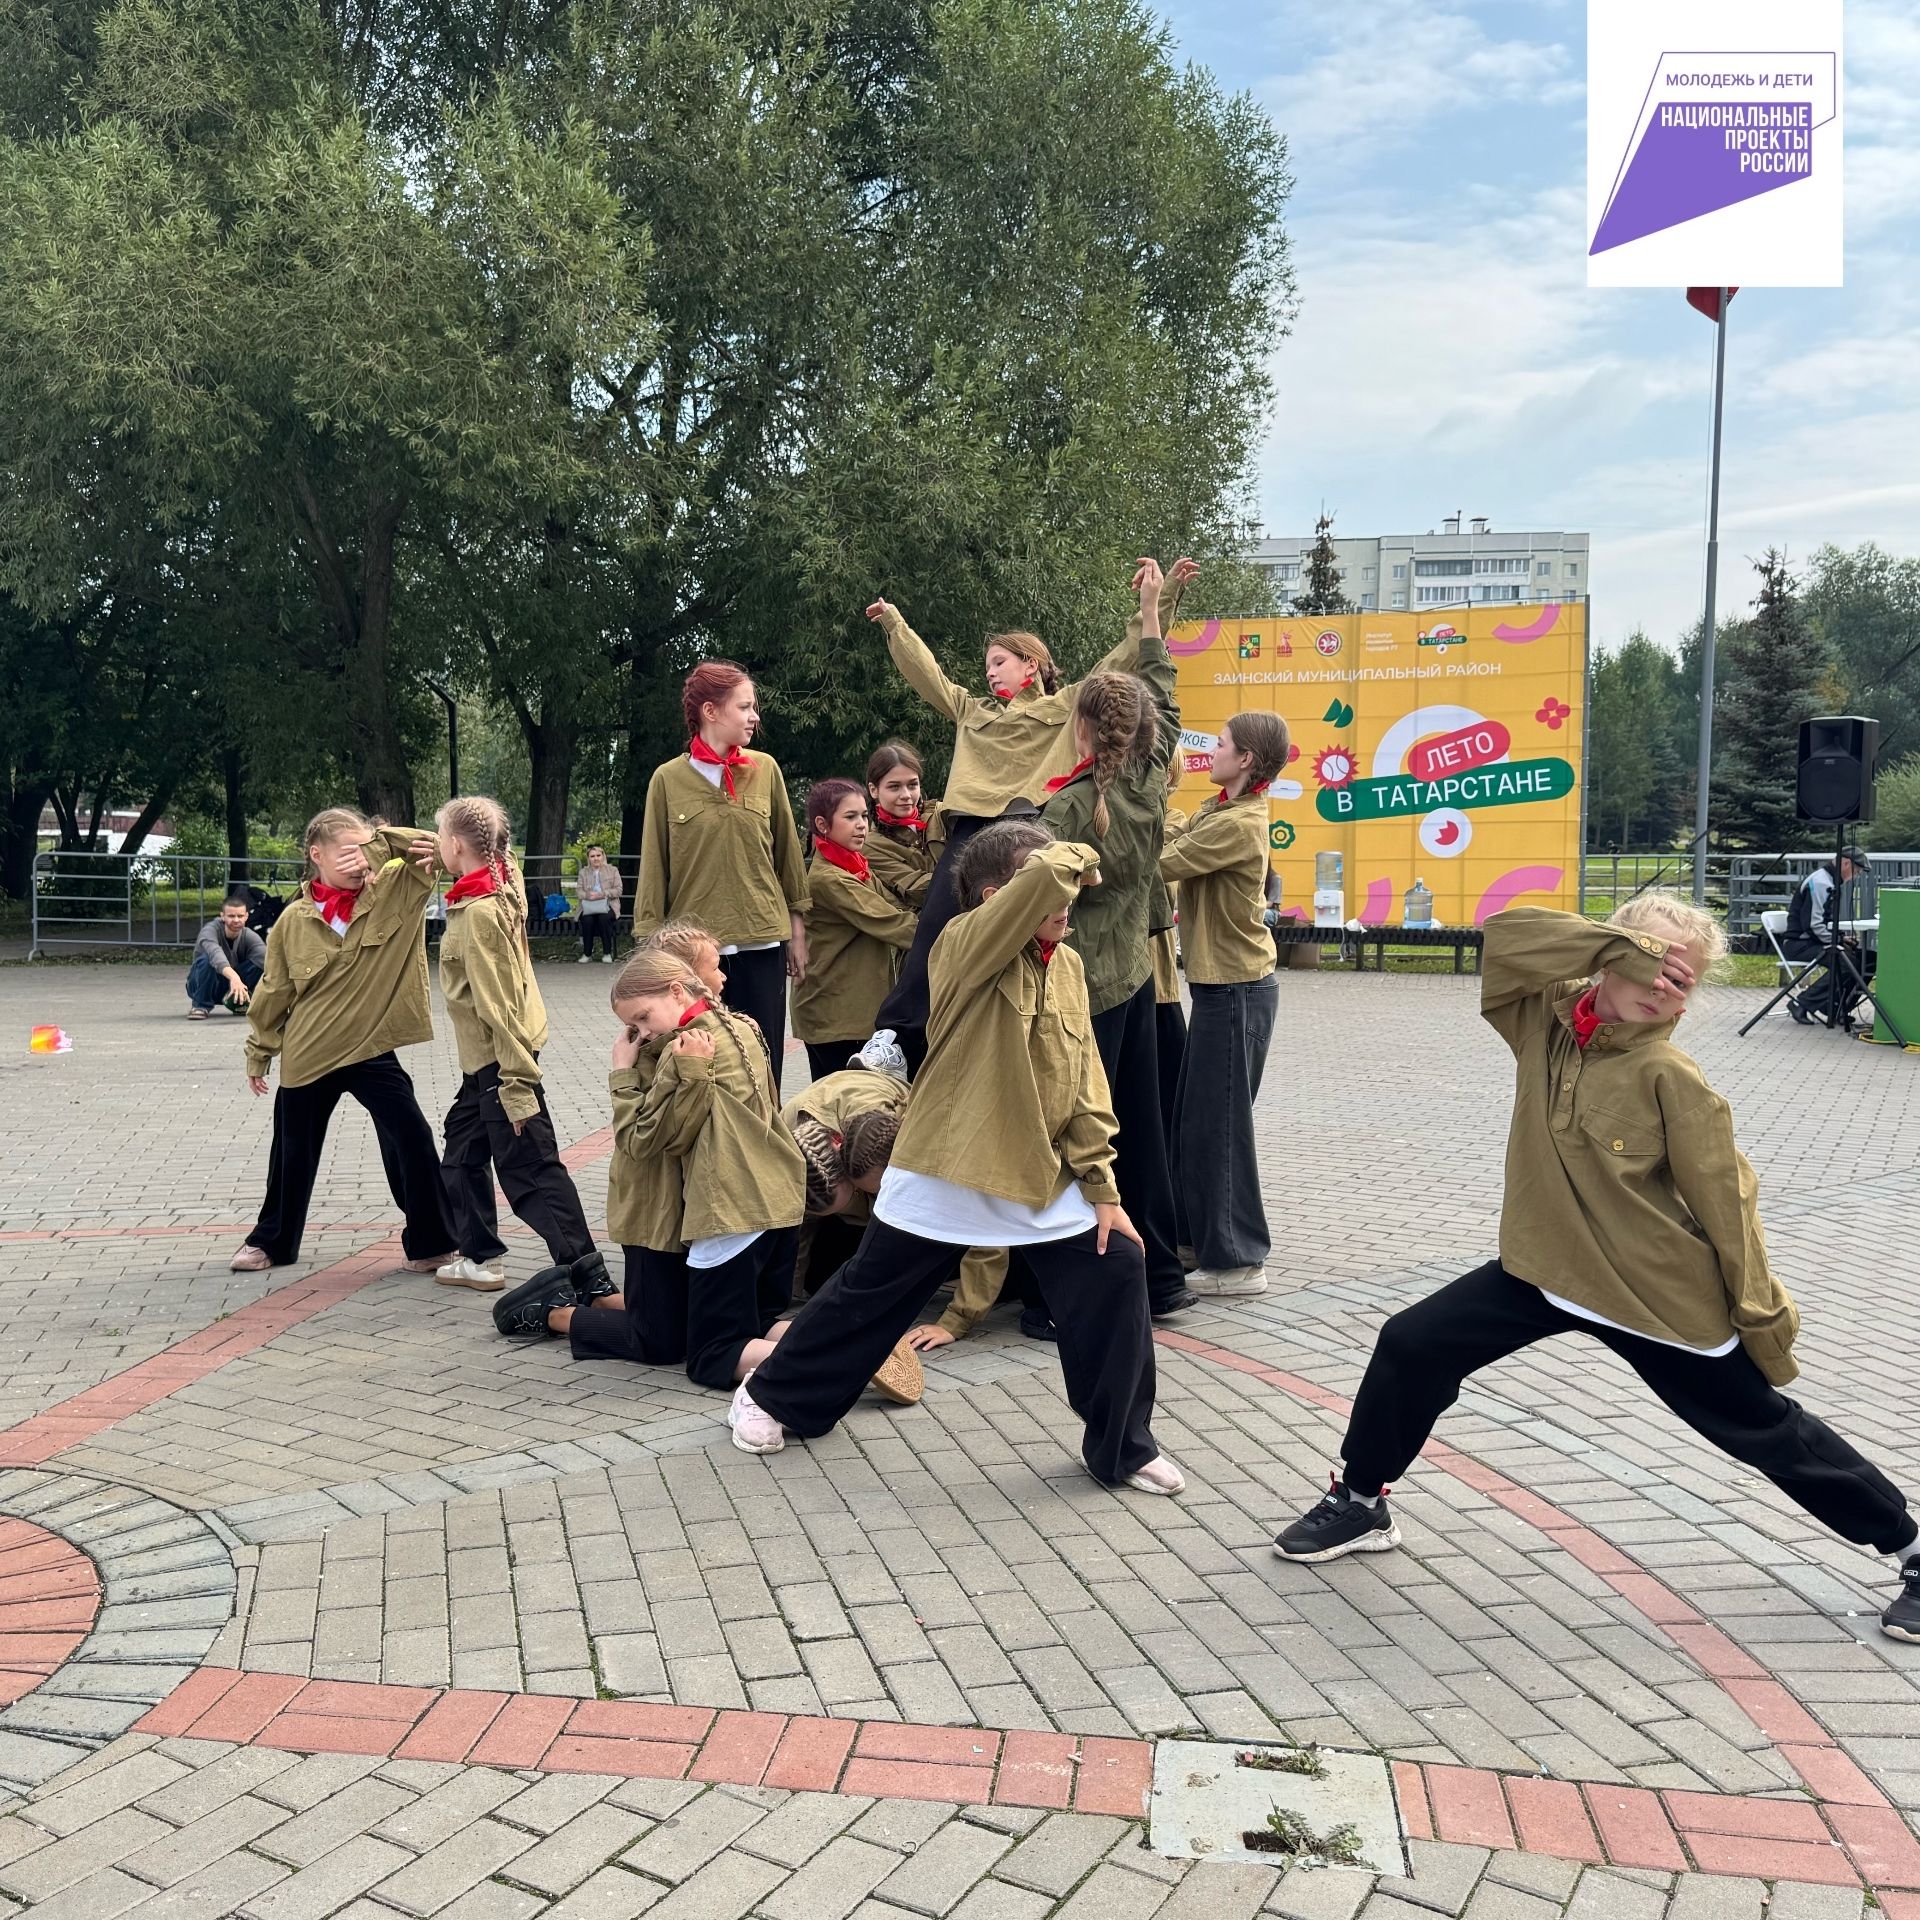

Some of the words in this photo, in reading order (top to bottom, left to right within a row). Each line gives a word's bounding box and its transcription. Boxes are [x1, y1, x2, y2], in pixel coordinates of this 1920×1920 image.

[1214, 670, 1293, 684] ЗАИНСКИЙ
[1297, 665, 1441, 682] МУНИЦИПАЛЬНЫЙ
[1446, 662, 1501, 677] РАЙОН
[1427, 731, 1494, 773] ЛЕТО
[1337, 791, 1353, 813] В
[1372, 768, 1552, 808] ТАТАРСТАНЕ
